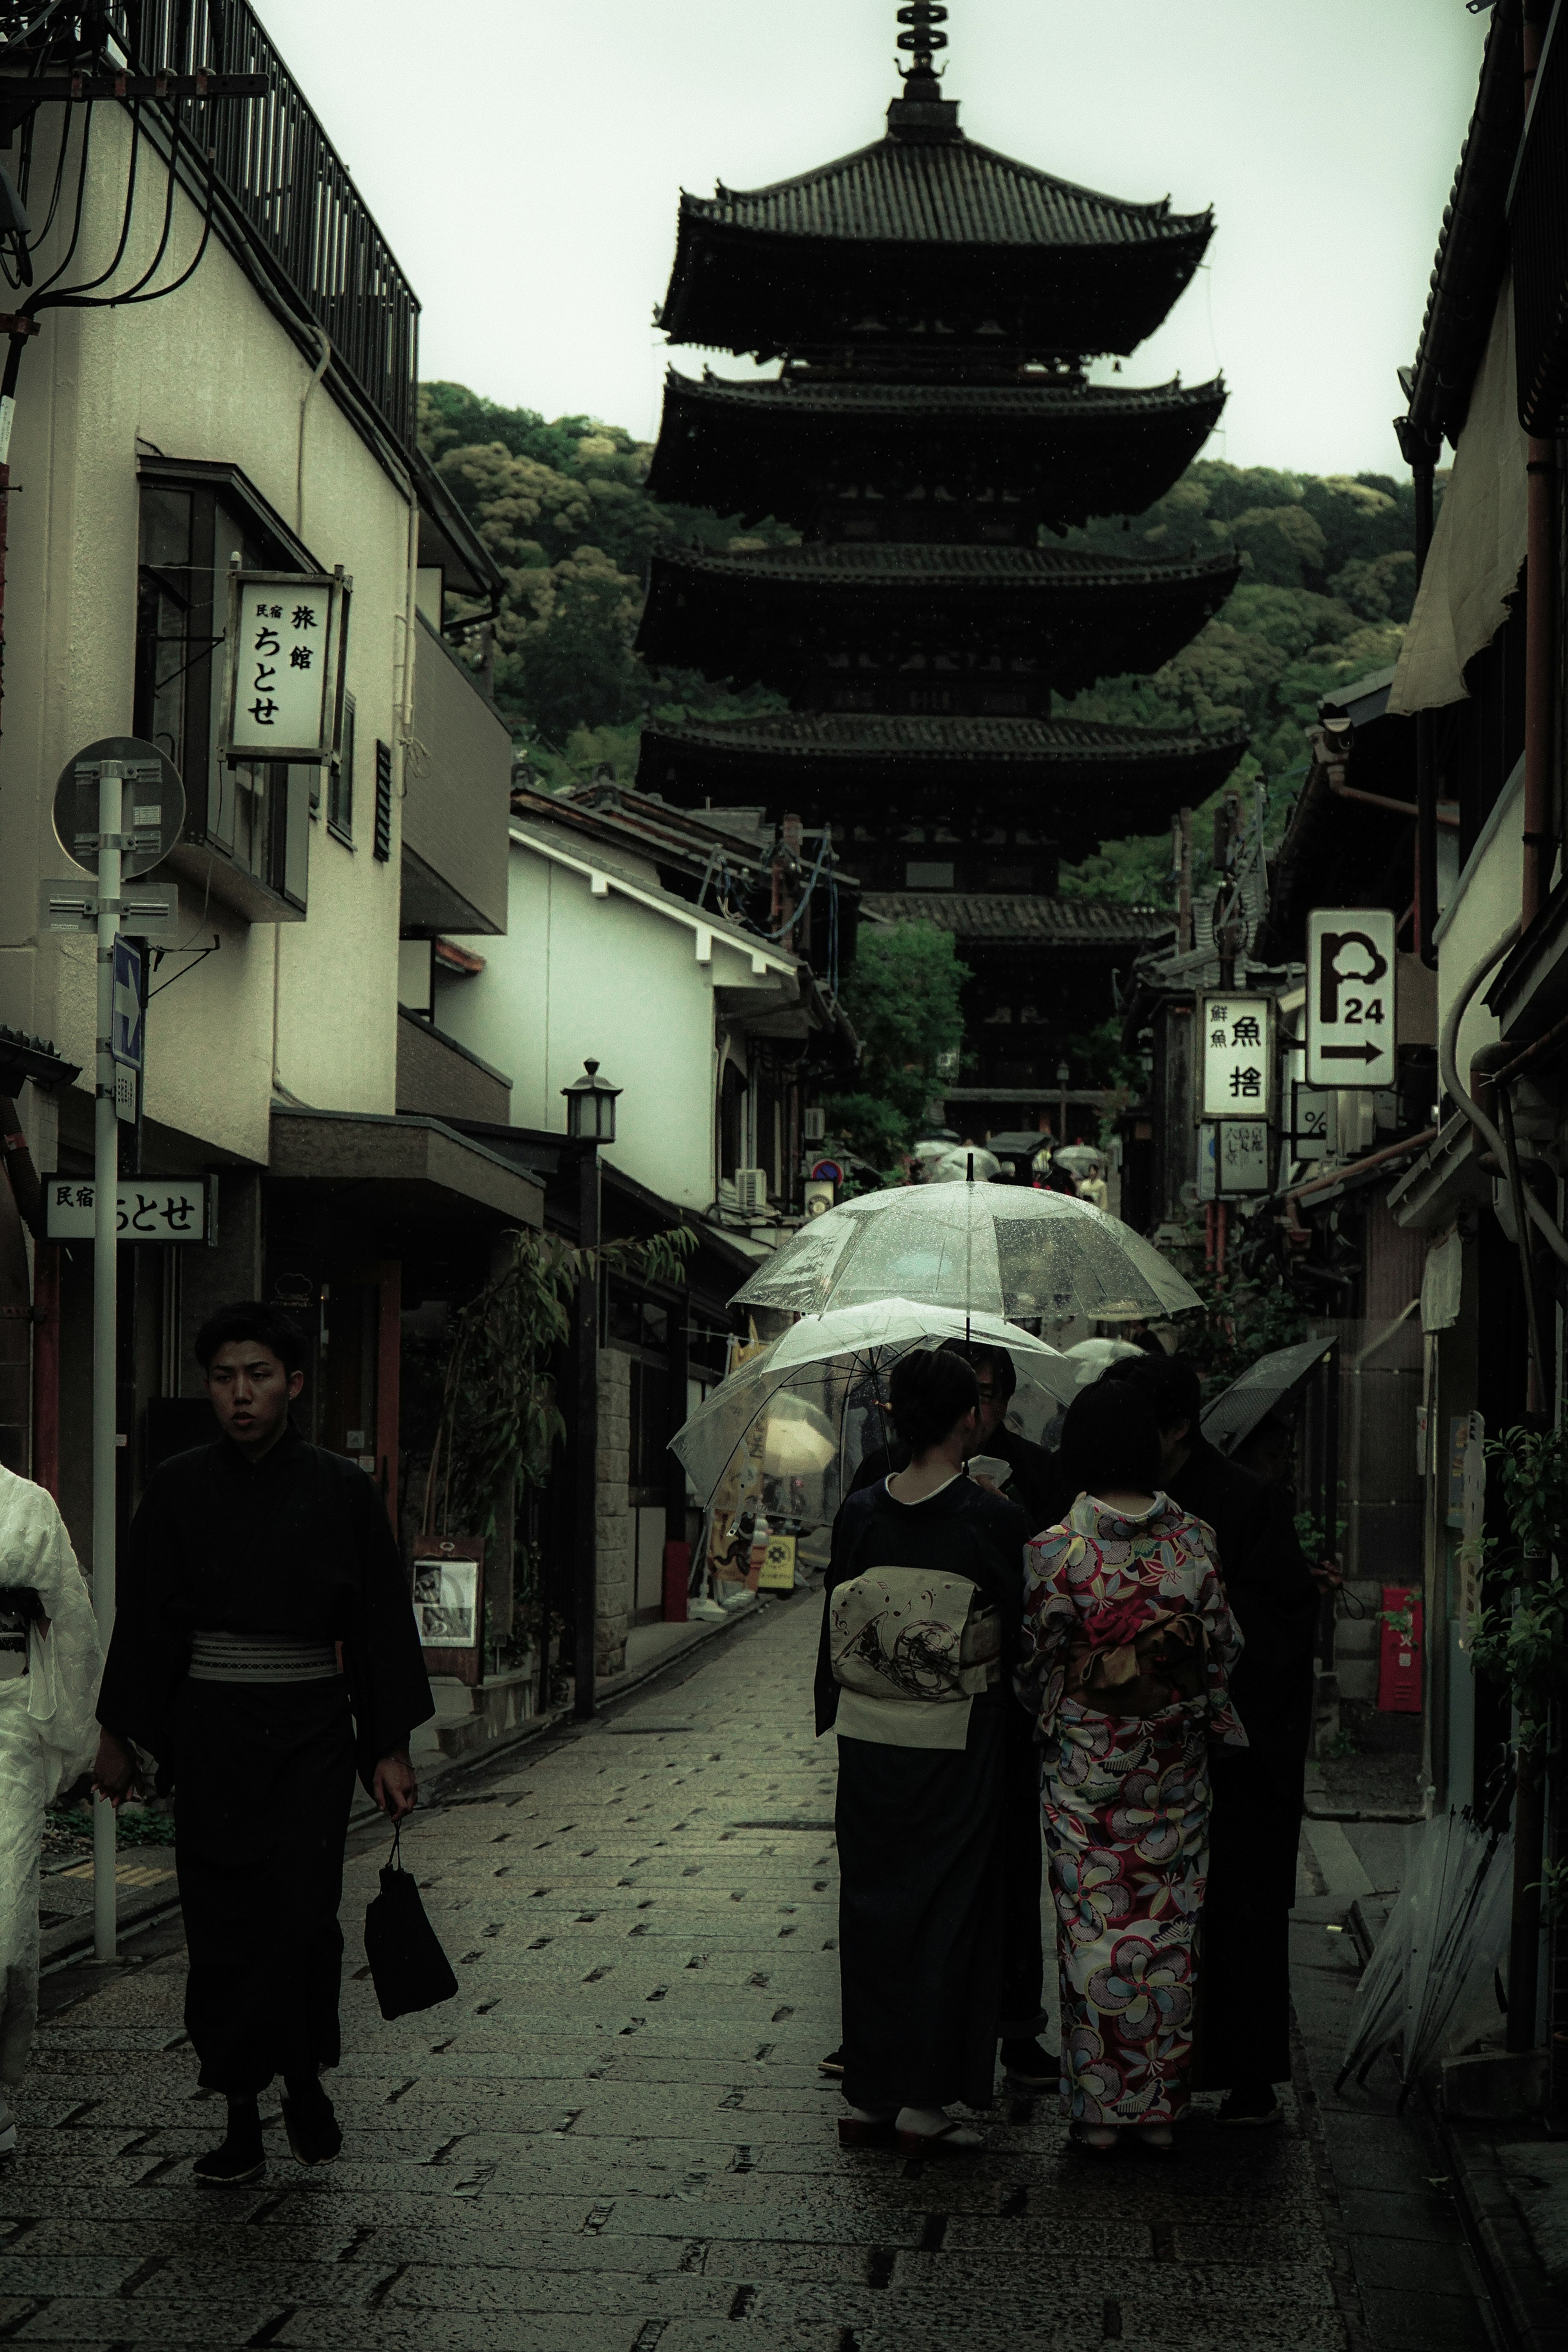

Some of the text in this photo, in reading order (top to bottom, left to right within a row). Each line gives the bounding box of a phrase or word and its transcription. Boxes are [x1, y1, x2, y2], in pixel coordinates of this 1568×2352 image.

[256, 604, 283, 618] 民宿
[290, 606, 317, 669] 旅館
[248, 627, 281, 725] ちとせ
[1211, 1005, 1227, 1048] 鮮魚
[1345, 999, 1385, 1024] 24
[1229, 1016, 1261, 1097] 魚捨
[56, 1186, 95, 1207] 民宿
